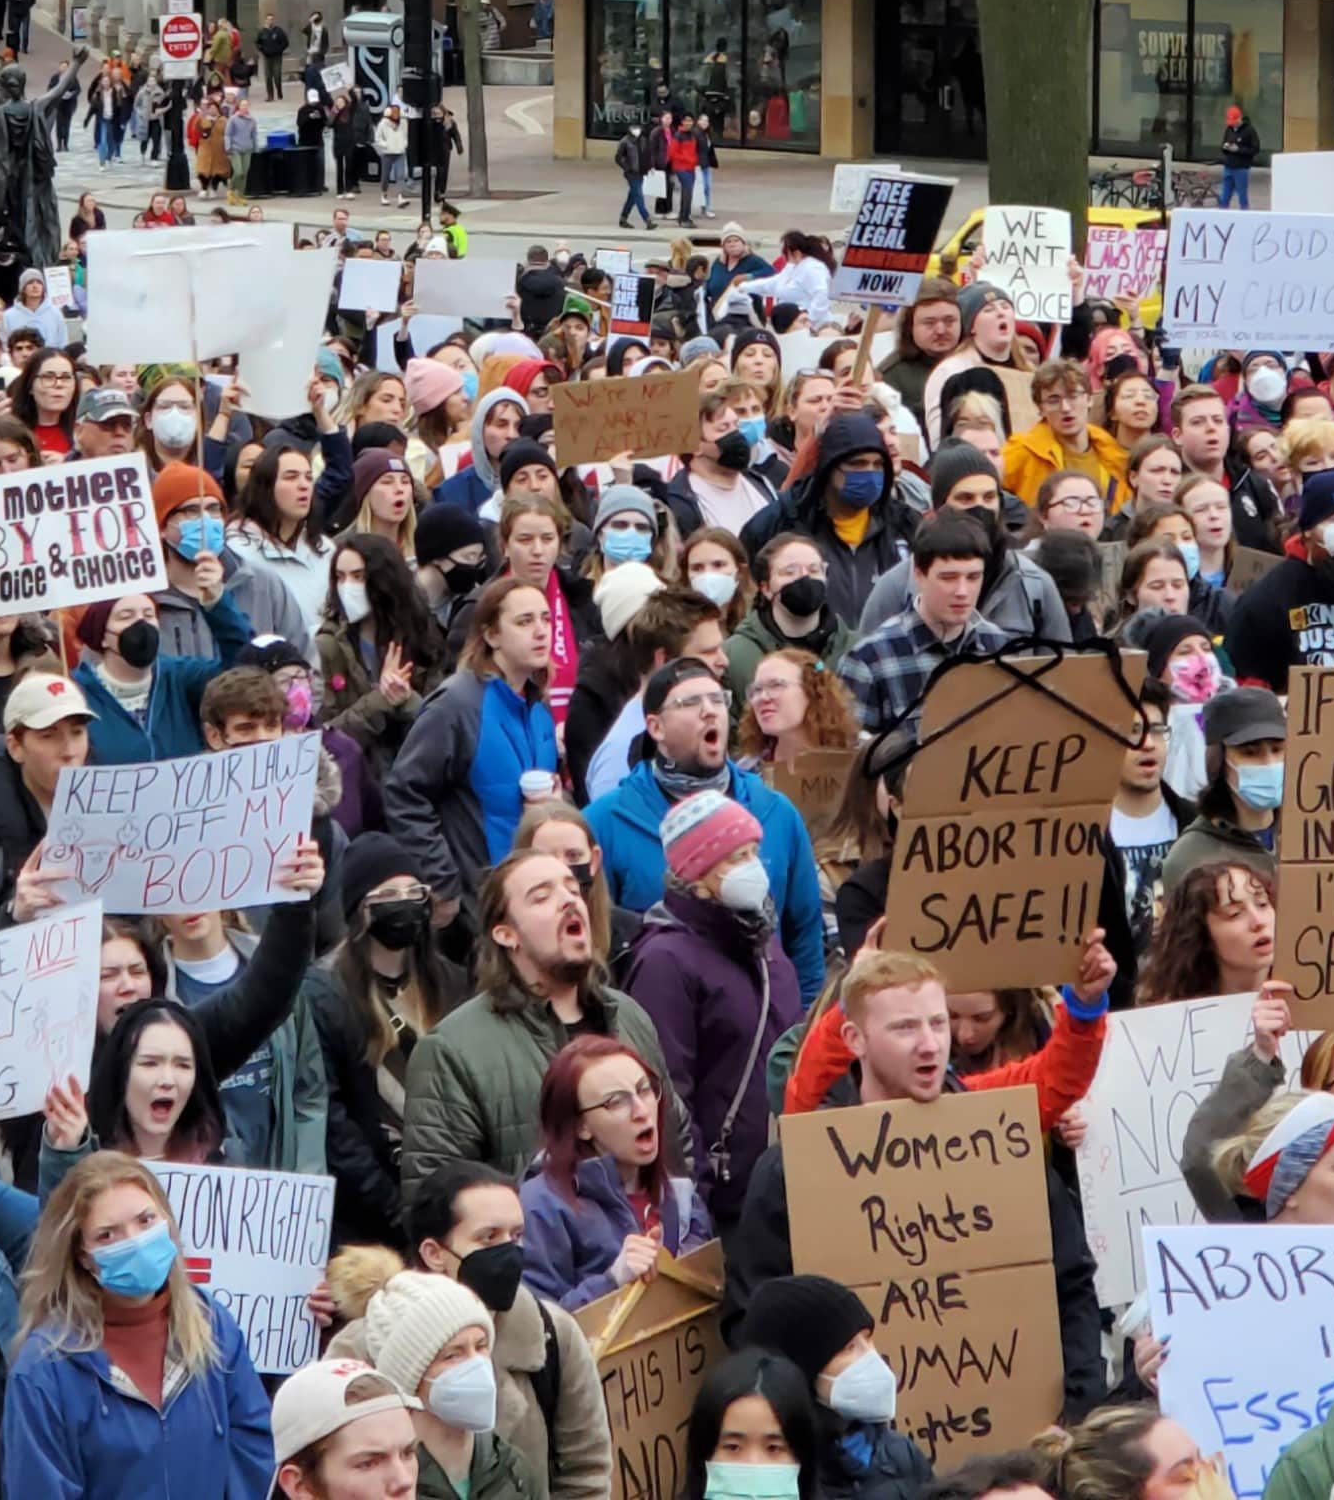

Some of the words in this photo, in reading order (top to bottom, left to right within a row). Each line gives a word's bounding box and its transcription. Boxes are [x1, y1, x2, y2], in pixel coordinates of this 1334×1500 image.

[860, 204, 906, 227] SAFE
[867, 180, 914, 205] FREE
[851, 224, 907, 250] LEGAL
[1001, 210, 1048, 238] WE
[1091, 228, 1127, 243] KEEP
[1180, 221, 1235, 261] MY
[856, 272, 903, 294] NOW!
[984, 244, 1066, 267] WANT
[1009, 267, 1030, 287] A
[1086, 245, 1130, 270] LAWS
[1173, 279, 1226, 324] MY
[65, 501, 152, 557] FOR
[48, 543, 68, 578] &
[65, 765, 159, 815] KEEP
[171, 752, 244, 809] YOUR
[251, 733, 317, 791] LAWS
[960, 733, 1087, 802] KEEP
[144, 803, 227, 851] OFF
[239, 783, 295, 837] MY
[901, 818, 1105, 874] ABORTION
[25, 915, 87, 974] NOT
[1120, 1003, 1219, 1088] WE
[825, 1111, 1031, 1179] Women's
[237, 1175, 333, 1267] RIGHTS
[861, 1192, 994, 1267] Rights
[879, 1272, 968, 1327] ARE
[601, 1351, 665, 1443] THIS
[674, 1325, 707, 1384] IS
[883, 1327, 1018, 1395] UMAN
[892, 1404, 992, 1460] ights
